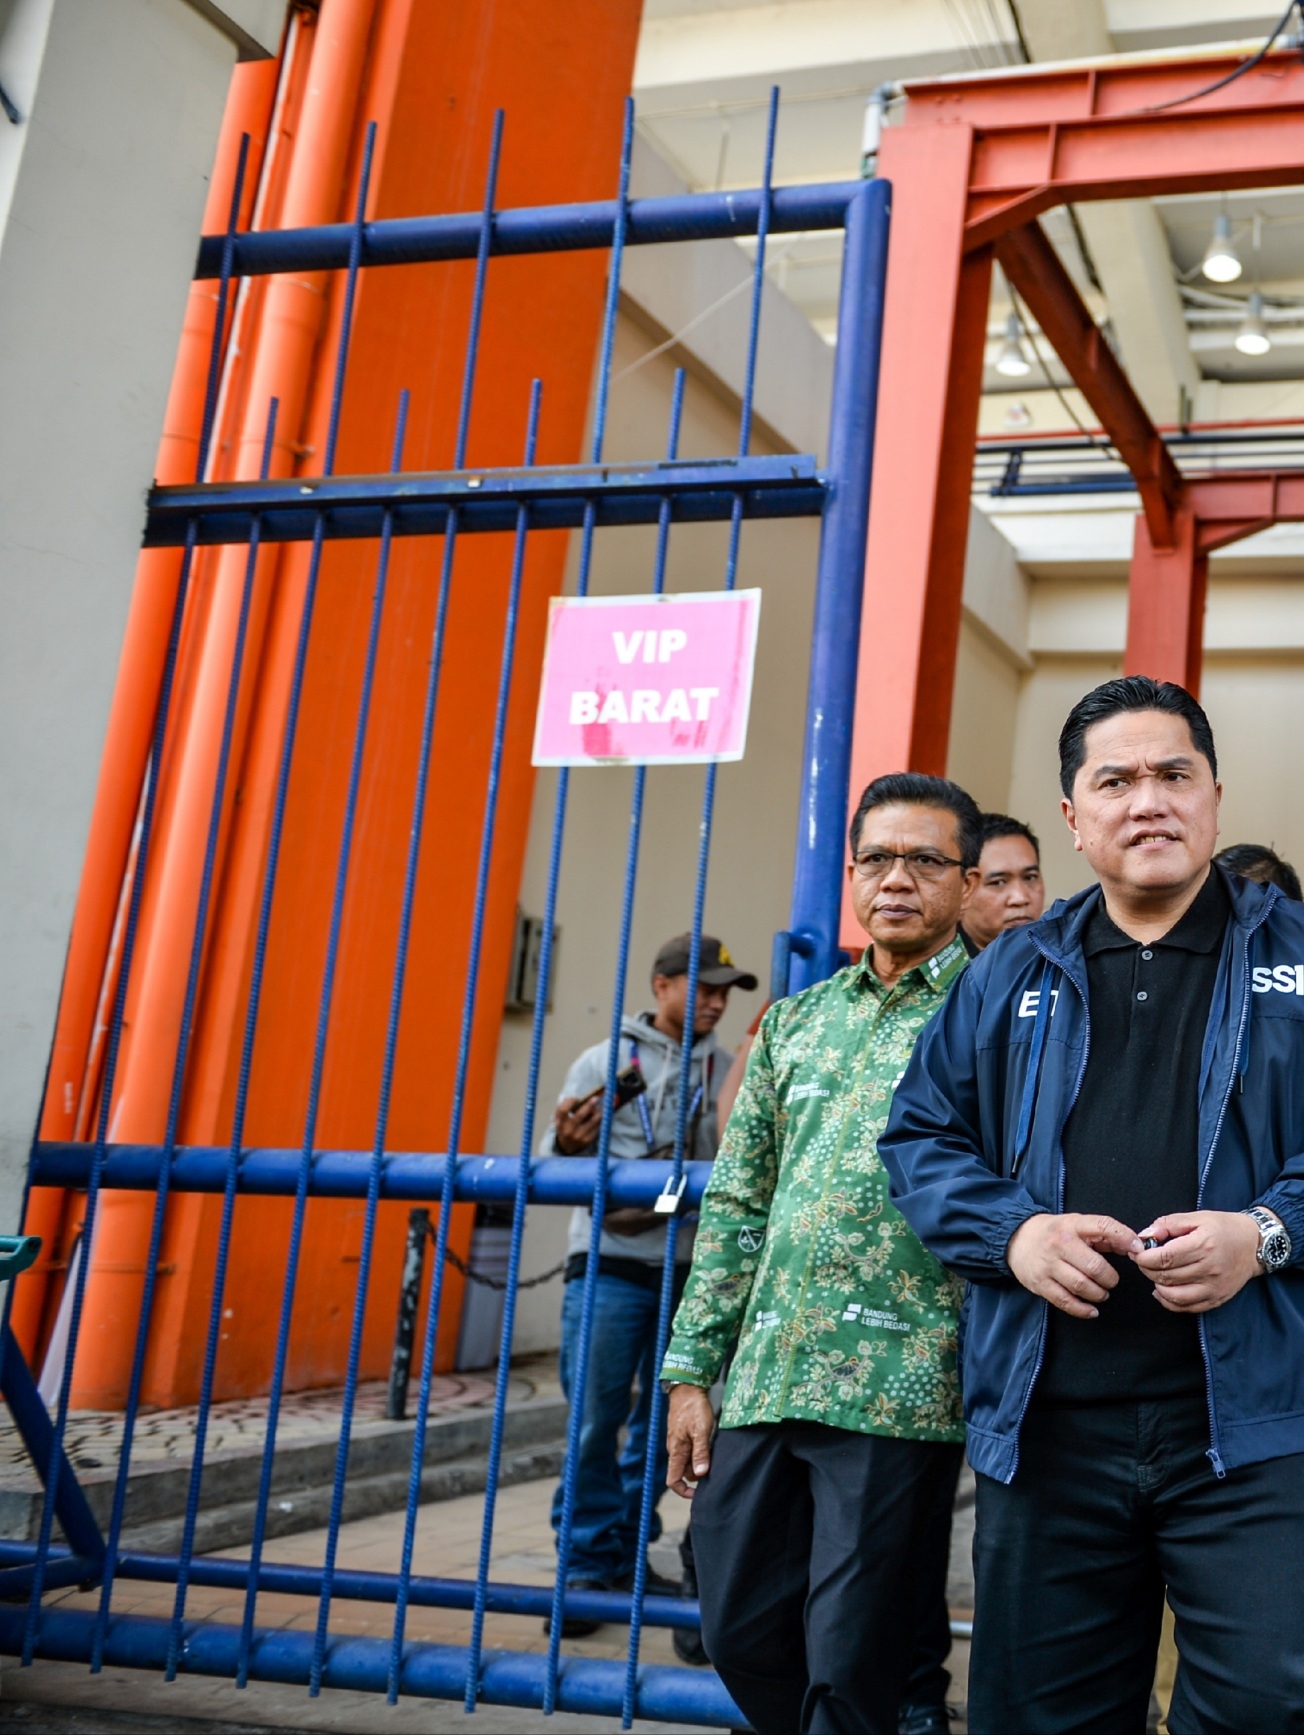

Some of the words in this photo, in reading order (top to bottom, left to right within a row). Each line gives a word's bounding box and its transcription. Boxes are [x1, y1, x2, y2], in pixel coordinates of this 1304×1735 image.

[612, 629, 688, 664] VIP
[569, 687, 719, 725] BARAT
[861, 1317, 882, 1327] LEBIH
[883, 1320, 911, 1332] BEDAS!
[863, 1308, 898, 1321] BANDUNG
